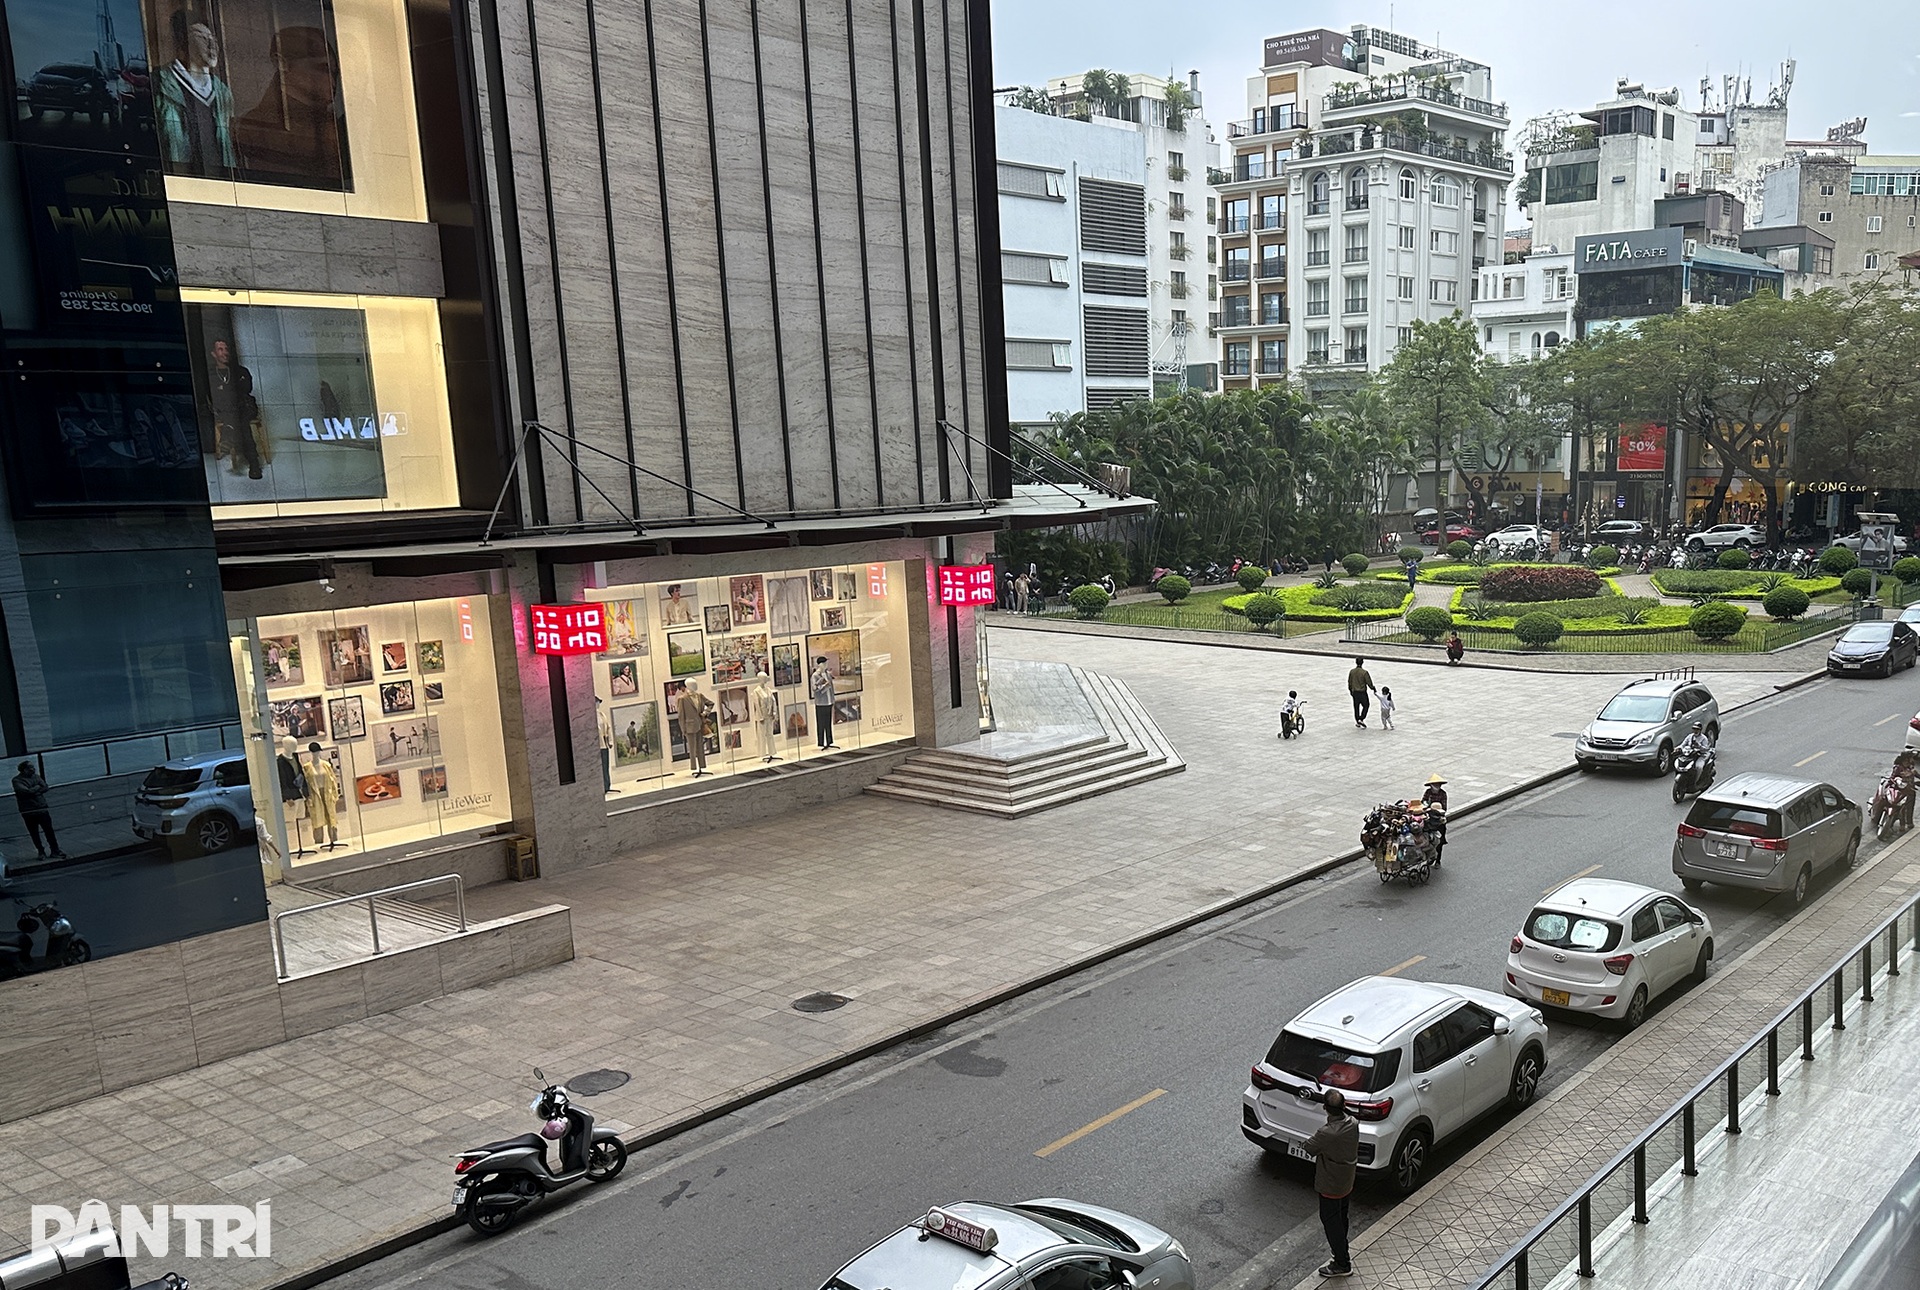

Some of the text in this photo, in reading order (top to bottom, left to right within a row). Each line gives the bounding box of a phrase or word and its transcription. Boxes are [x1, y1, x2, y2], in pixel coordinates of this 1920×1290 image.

[1585, 240, 1667, 262] FATA CAFE
[1628, 440, 1656, 452] 50%
[871, 713, 904, 727] LifeWear
[442, 793, 493, 811] LifeWear
[946, 1218, 957, 1226] TAXI
